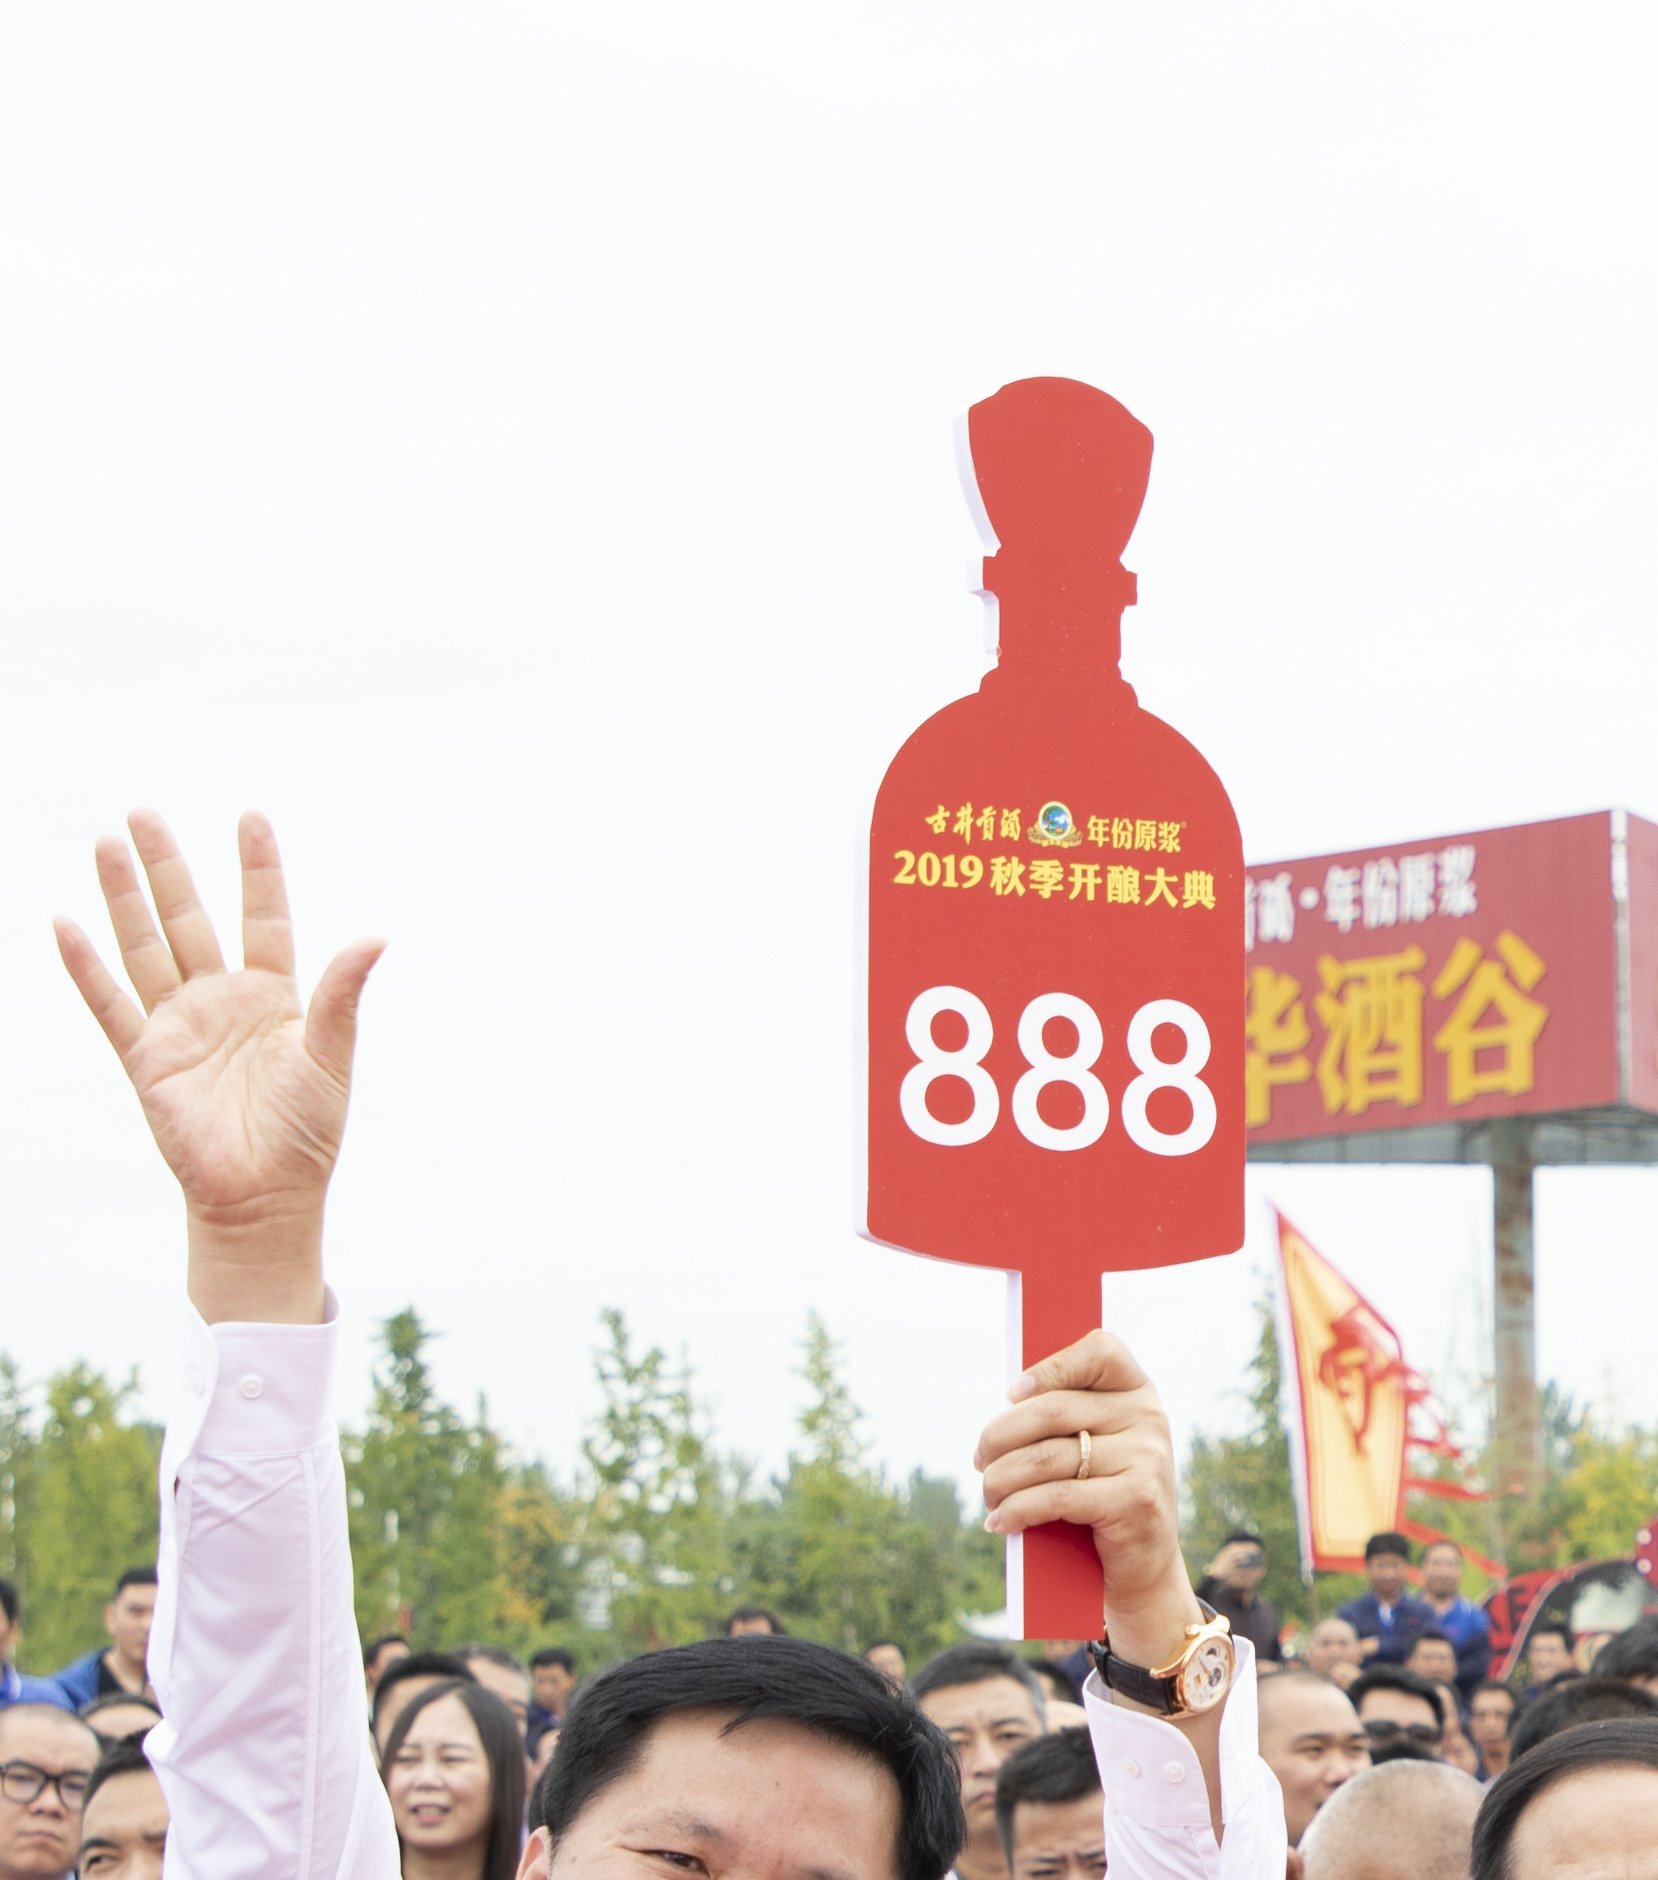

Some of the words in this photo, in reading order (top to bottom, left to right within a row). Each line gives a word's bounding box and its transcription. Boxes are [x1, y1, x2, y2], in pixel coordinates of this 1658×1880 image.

[925, 802, 1022, 844] 古井贡酒
[1086, 815, 1181, 853] 年份原浆
[1245, 843, 1478, 952] 酒·年份原浆
[899, 985, 1217, 1157] 888
